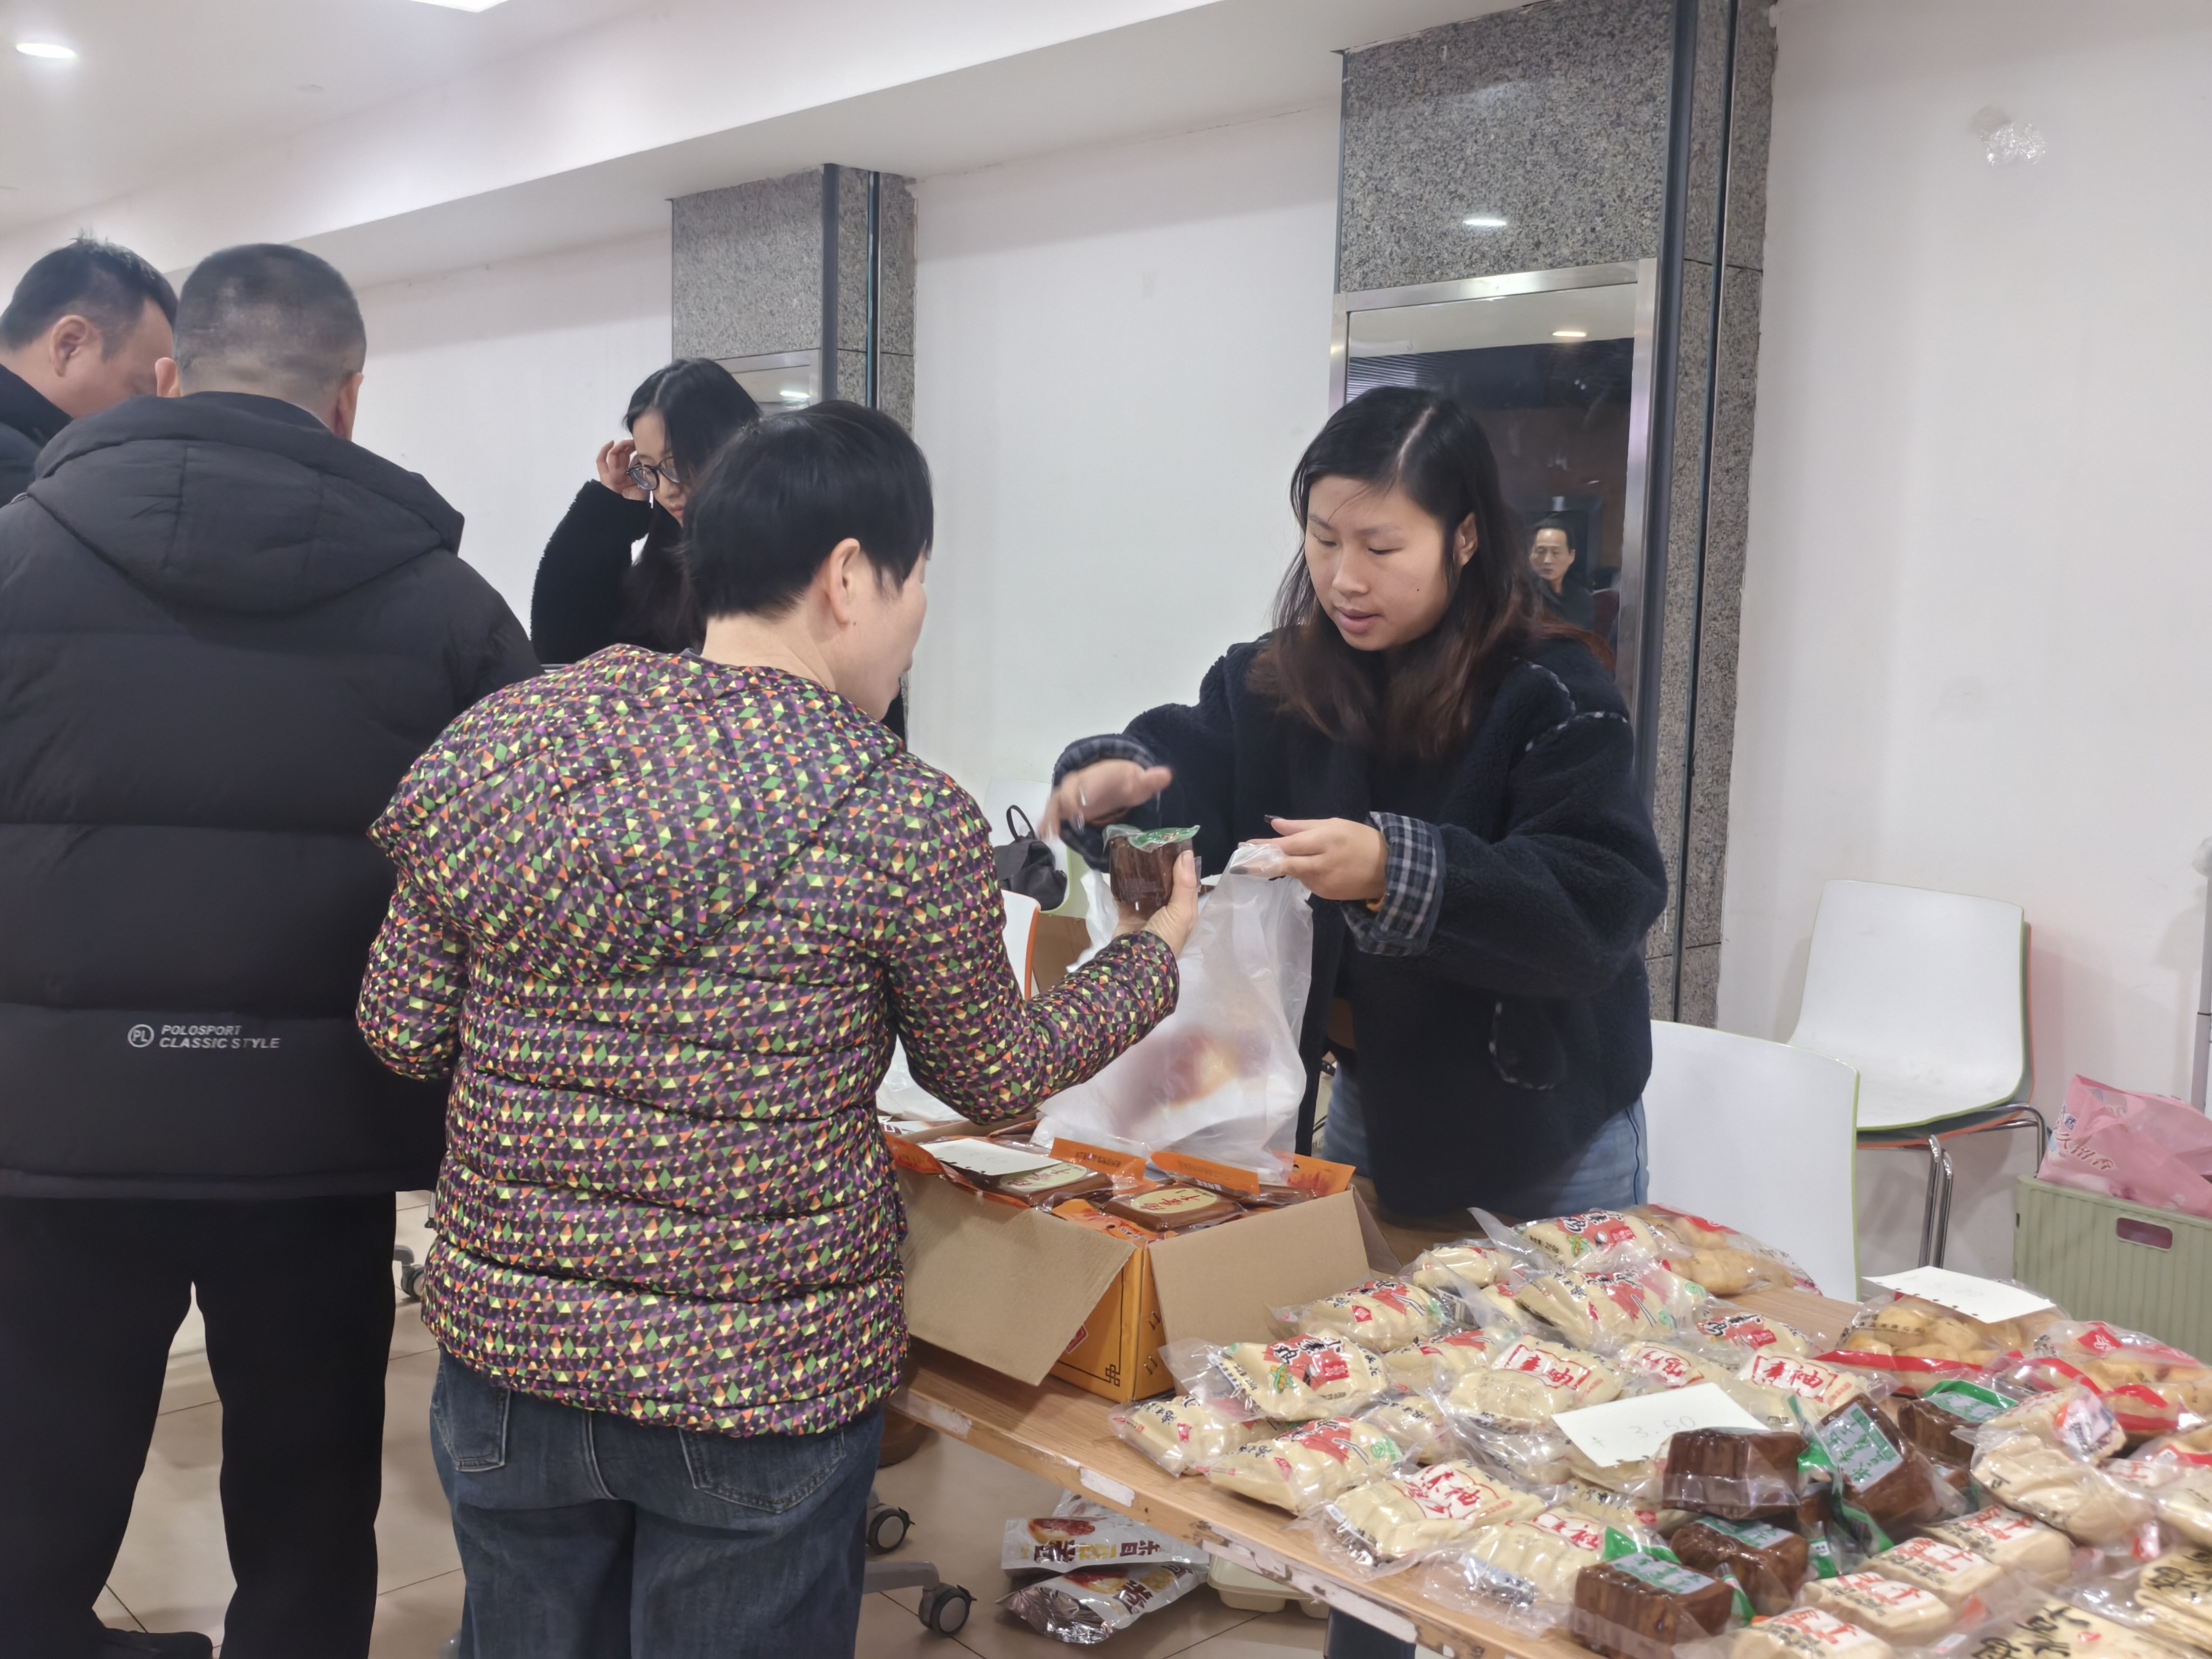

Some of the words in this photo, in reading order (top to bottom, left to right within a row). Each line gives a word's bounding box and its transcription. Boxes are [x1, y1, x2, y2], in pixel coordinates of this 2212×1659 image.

[161, 1025, 242, 1036] POLOSPORT
[159, 1037, 227, 1049] CLASSIC
[231, 1037, 281, 1049] STYLE
[1628, 1415, 1696, 1438] 3.50
